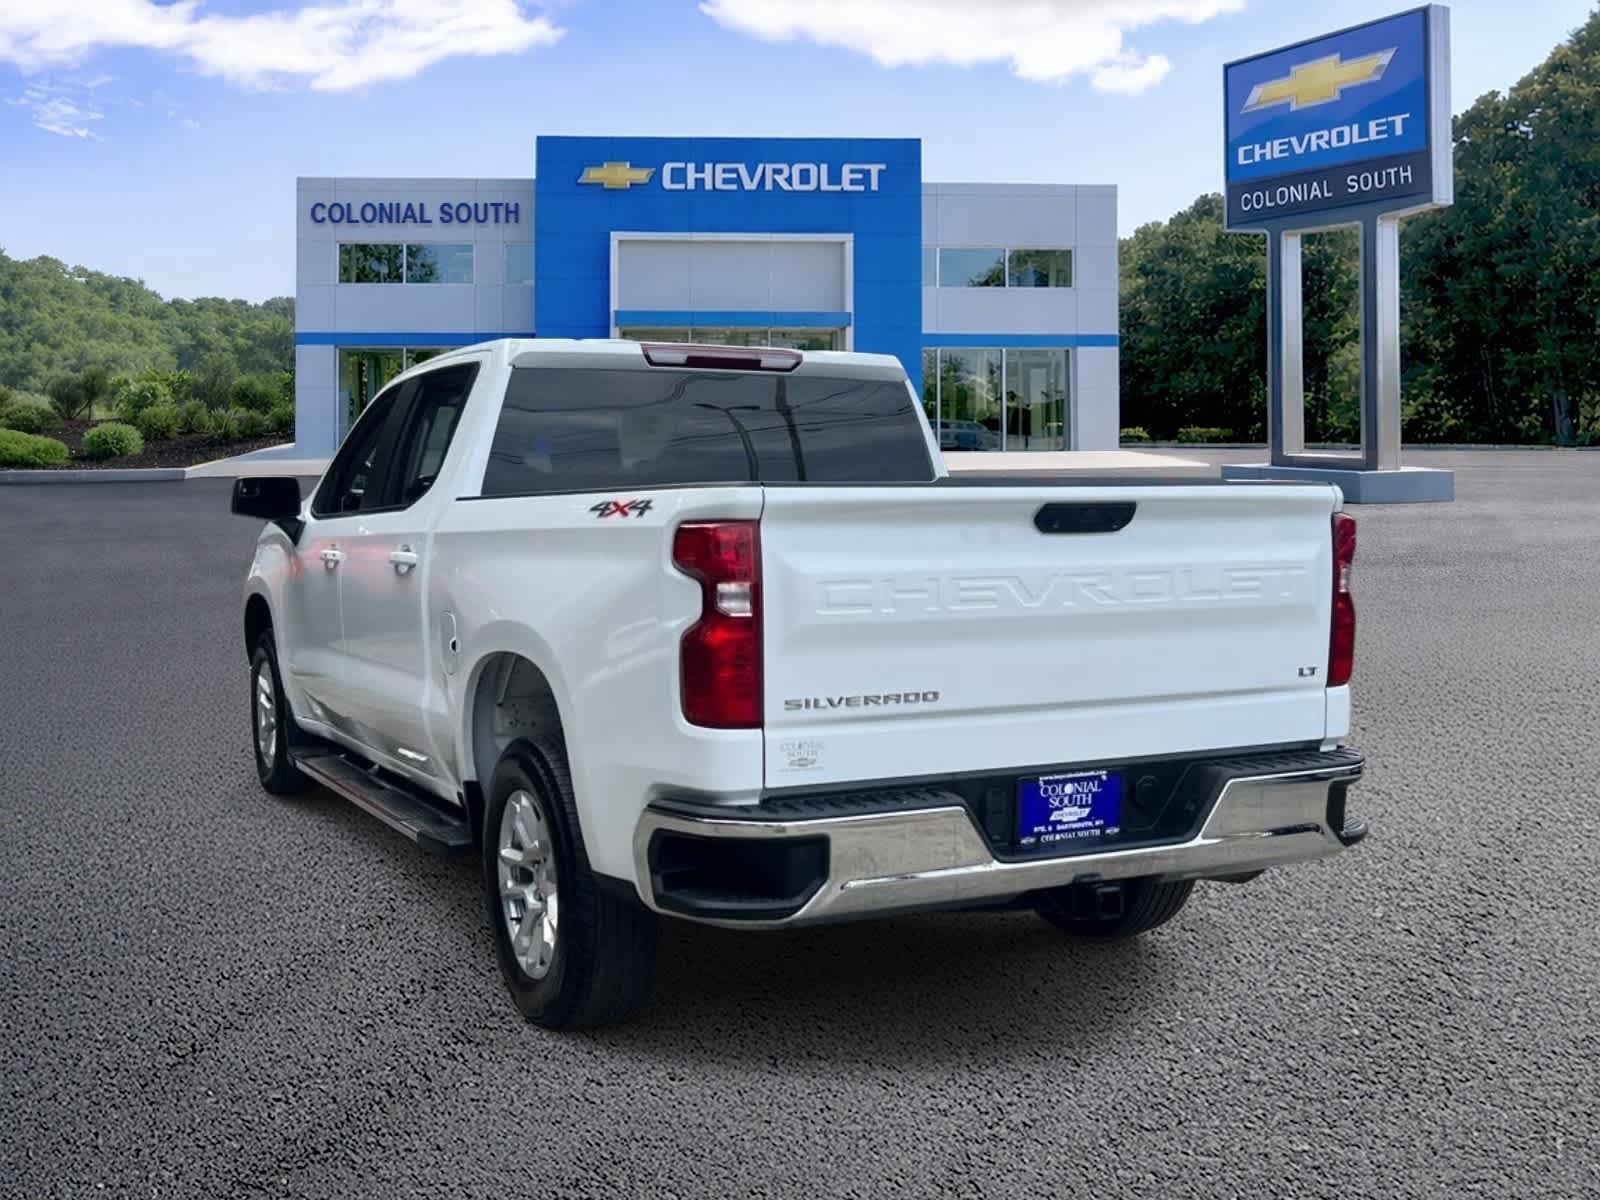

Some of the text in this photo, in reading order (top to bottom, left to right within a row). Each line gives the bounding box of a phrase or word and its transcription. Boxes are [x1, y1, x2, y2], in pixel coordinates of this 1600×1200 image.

[1238, 113, 1410, 165] CHEVROLET
[661, 162, 887, 192] CHEVROLET
[1241, 165, 1412, 211] COLONIAL SOUTH
[310, 201, 520, 225] COLONIAL SOUTH
[815, 566, 1308, 616] CHEVROLET
[1298, 666, 1318, 677] LT
[784, 691, 939, 711] SILVERADO
[1040, 780, 1103, 797] COLONIAL
[1048, 793, 1092, 808] SOUTH
